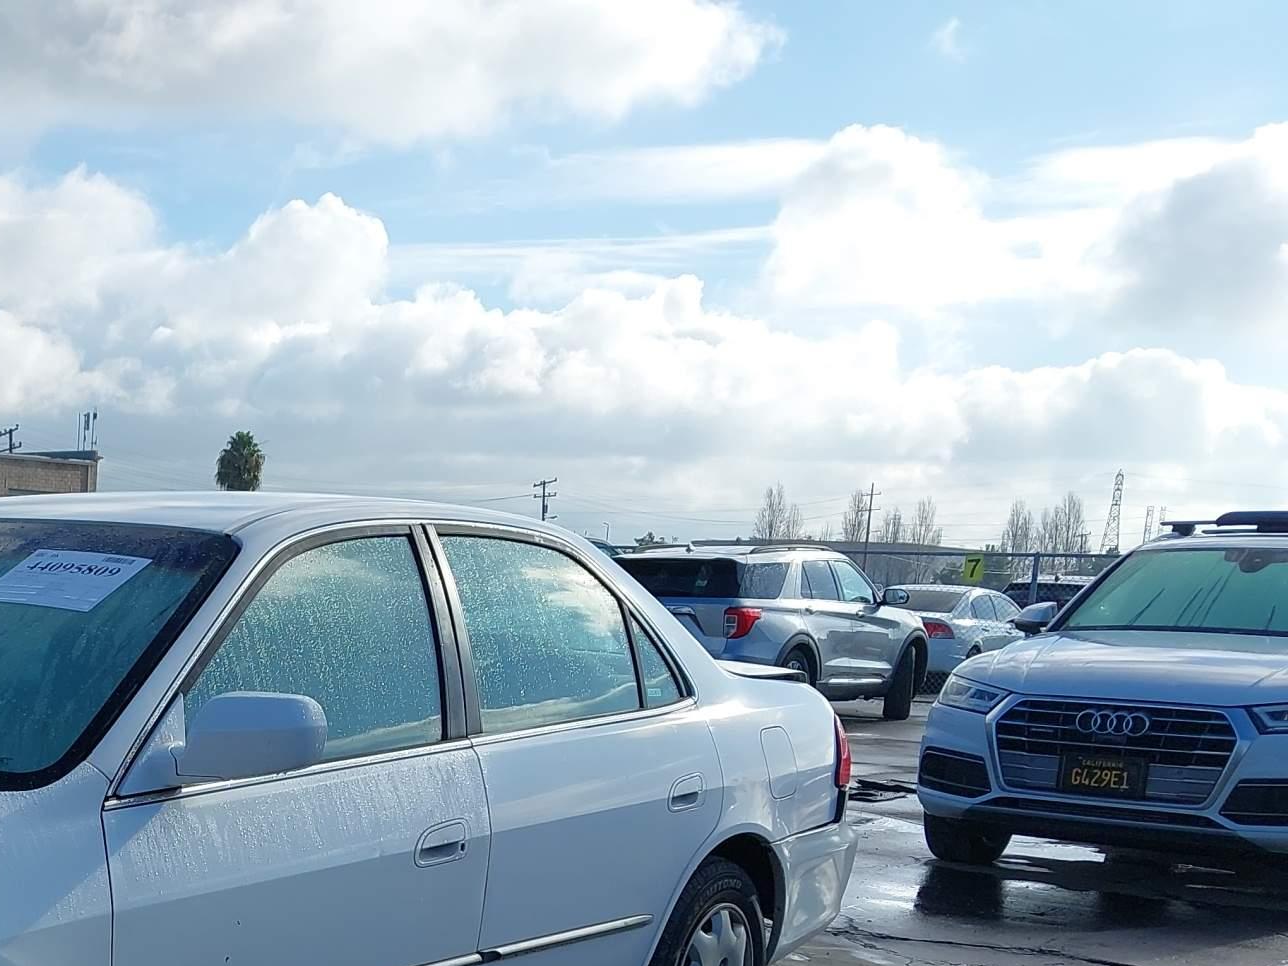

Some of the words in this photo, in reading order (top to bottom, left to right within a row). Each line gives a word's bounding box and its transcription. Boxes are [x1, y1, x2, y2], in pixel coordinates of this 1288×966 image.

[27, 560, 121, 577] 44095809
[967, 558, 981, 578] 7
[1071, 767, 1129, 789] G429E1
